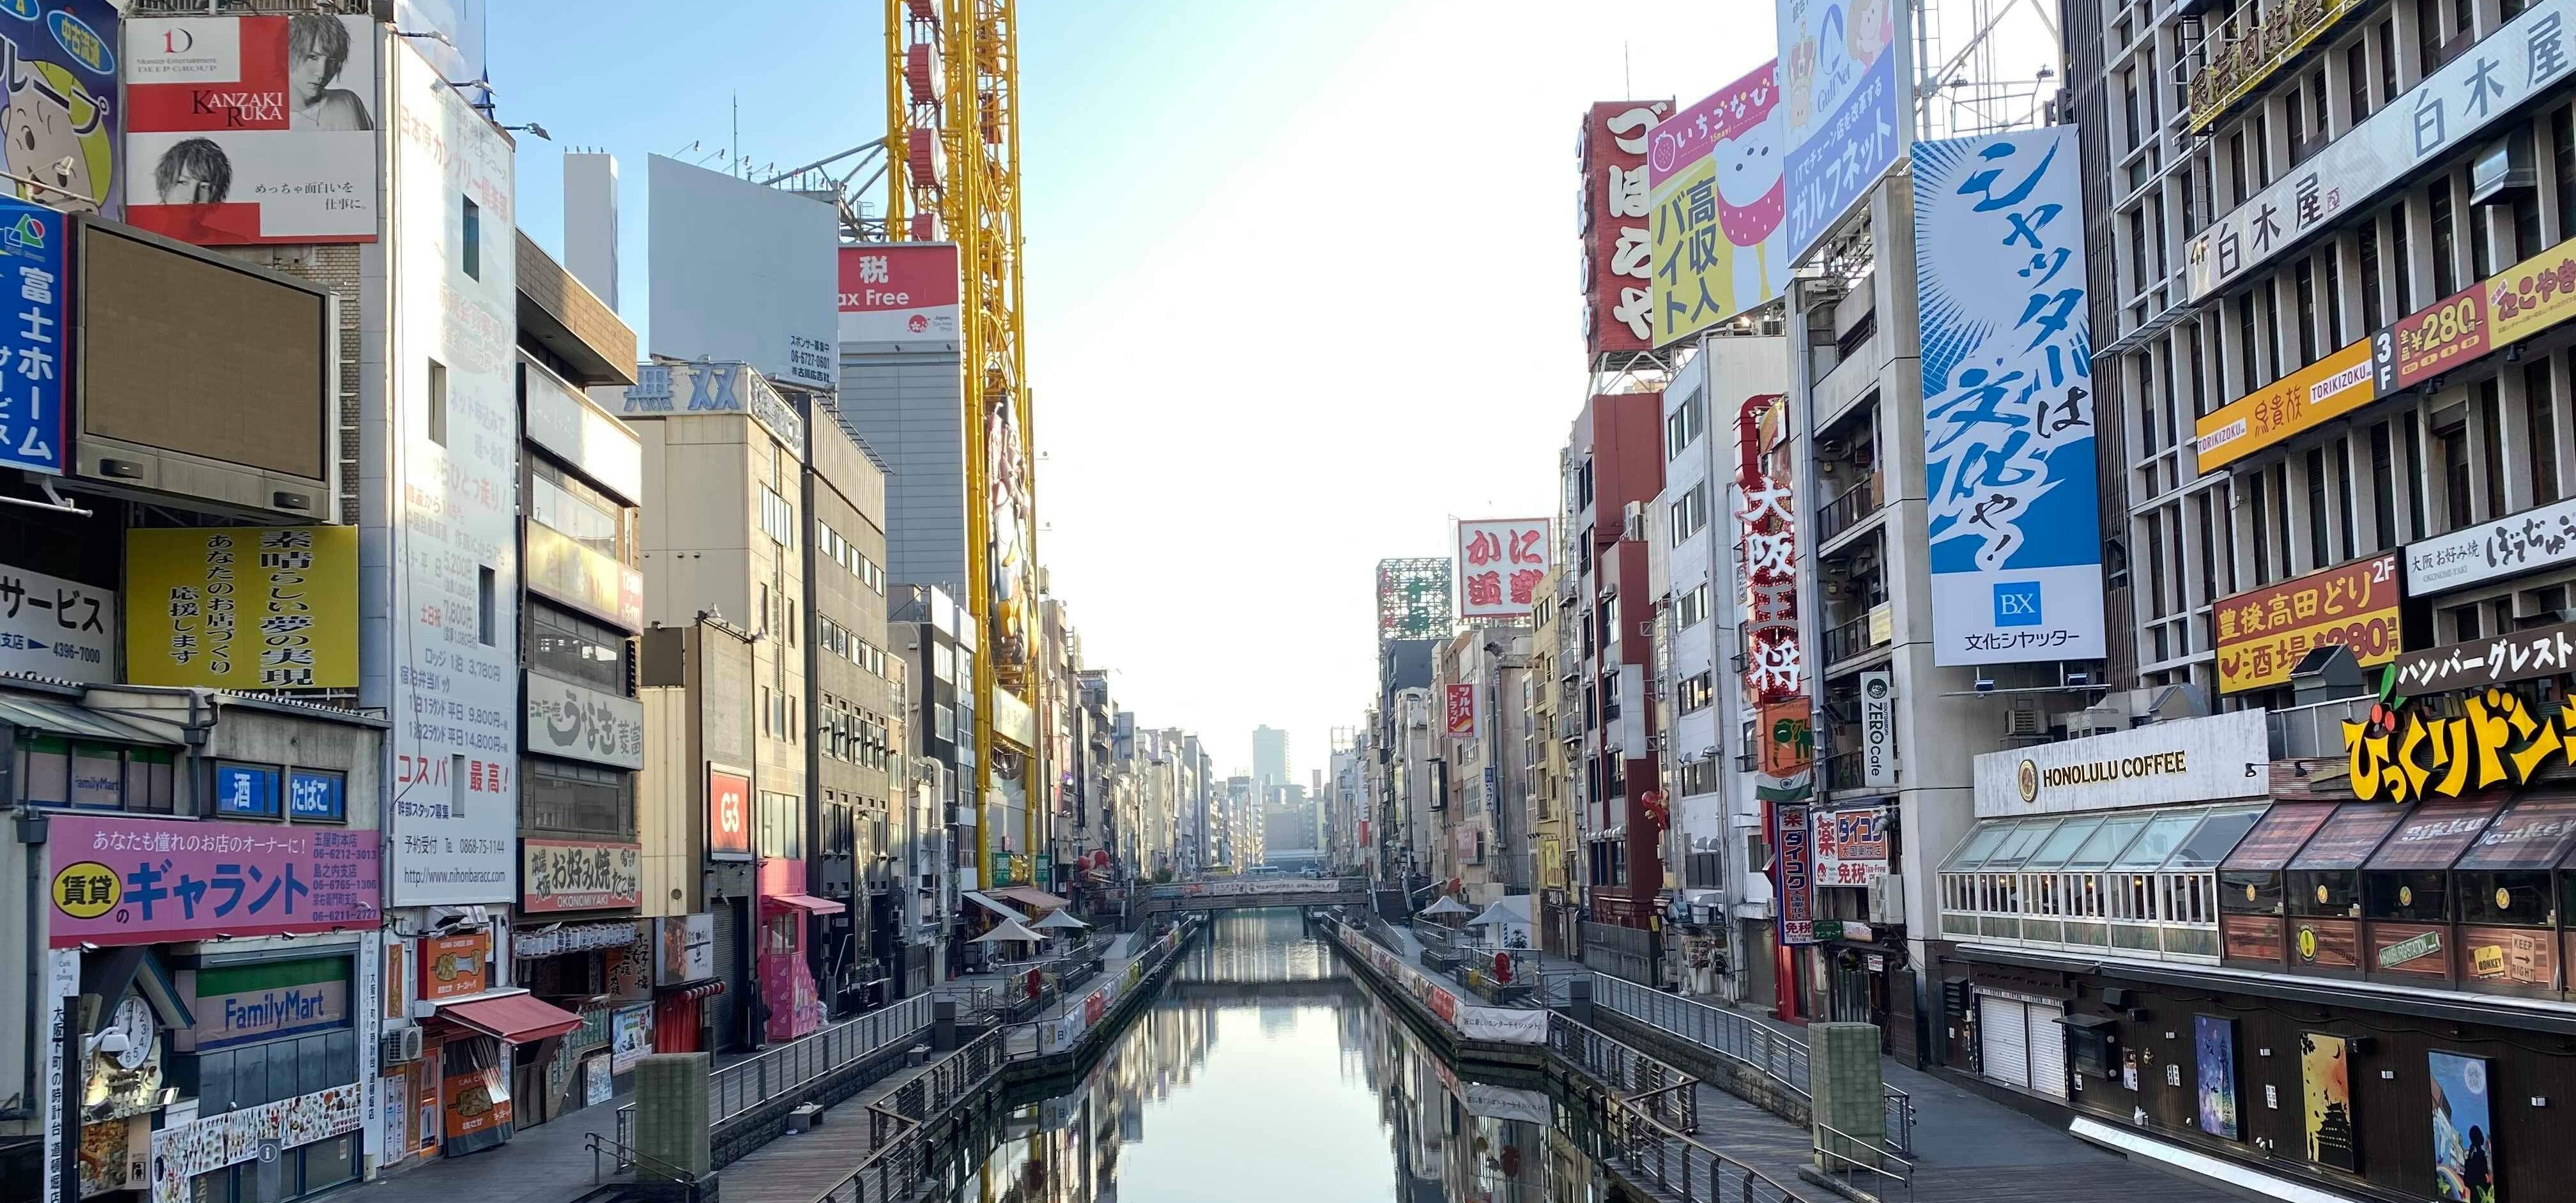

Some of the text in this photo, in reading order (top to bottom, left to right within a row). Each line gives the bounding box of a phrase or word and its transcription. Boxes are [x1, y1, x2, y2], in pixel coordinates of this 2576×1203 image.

[1818, 63, 1851, 113] GulfNet
[2414, 10, 2568, 158] 白木屋
[192, 89, 283, 115] KANZAKI
[227, 105, 283, 126] RUKA
[1676, 78, 1770, 148] いちごなび
[1795, 75, 1882, 187] ITでチェーン店を改革する
[255, 181, 353, 195] めっちゃ面白いを
[1793, 107, 1891, 246] ガルフネット
[325, 197, 367, 211] 仕事に。
[1607, 102, 1667, 341] づぼらや
[2219, 172, 2324, 280] 白木屋
[1657, 193, 1688, 335] バイト
[1686, 175, 1719, 324] 高収入
[859, 256, 889, 285] 税
[838, 289, 910, 307] ax Free
[2411, 296, 2476, 351] ¥280
[791, 335, 829, 353] スポンサー募集中
[791, 349, 829, 370] 06-6727-0601
[17, 266, 53, 461] 富士ホーム
[2312, 365, 2366, 401] TORIKIZOKU
[2255, 386, 2303, 438] 鳥貴族
[2198, 422, 2241, 453] TORIKIZOKU
[1466, 529, 1543, 565] かに
[2412, 540, 2480, 573] 大阪 お好み焼
[2487, 516, 2576, 568] ぼてぢゅう
[1735, 475, 1801, 693] 大阪王将
[2218, 557, 2395, 639] 豊後高田どり 2F
[0, 576, 104, 636] サービス
[206, 534, 236, 674] あなたのお店づくり
[259, 530, 315, 687] 素晴らしい夢の実現
[443, 599, 473, 629] 7,800円
[2000, 593, 2036, 615] BX
[169, 586, 199, 665] 応援します
[52, 641, 101, 664] 4396-7000
[425, 648, 500, 682] ロッジ 1泊 3,780円
[2245, 634, 2308, 680] 酒場
[448, 701, 463, 721] 平日
[1459, 687, 1471, 716] ツルハ
[448, 727, 463, 746] 平日
[547, 689, 617, 756] うなぎ
[1869, 702, 1885, 776] ZERO cafe
[399, 755, 509, 794] コスパ 最高!
[2043, 749, 2187, 788] HONOLULU COFFEE
[234, 773, 250, 808] 酒
[291, 779, 328, 811] たばこ
[397, 801, 450, 820] 幹部スタッフ募集
[721, 792, 740, 832] G3
[93, 831, 306, 854] あなたも憧れのお店のオーナーに!
[404, 836, 437, 854] 予約受付
[460, 840, 504, 854] 0868-75-1144
[1839, 816, 1884, 843] ダイコク
[313, 849, 378, 859] 06-6212-3013
[314, 863, 357, 878] 島之内支店
[552, 847, 610, 891] お好み焼
[1784, 831, 1806, 890] ダイコク
[1866, 864, 1886, 873] Tax-Free
[62, 875, 112, 906] 賃貸
[404, 866, 505, 887] http://www.nihonbaracc.com
[1837, 863, 1866, 884] 免税
[116, 858, 309, 924] の ギャラント
[557, 895, 608, 908] OKONOMIYAKI
[1786, 922, 1812, 933] 免税
[2513, 937, 2533, 951] KEEP
[2478, 958, 2502, 970] DONKEY
[2512, 964, 2535, 979] RIGHT
[224, 990, 324, 1031] FamilyMart
